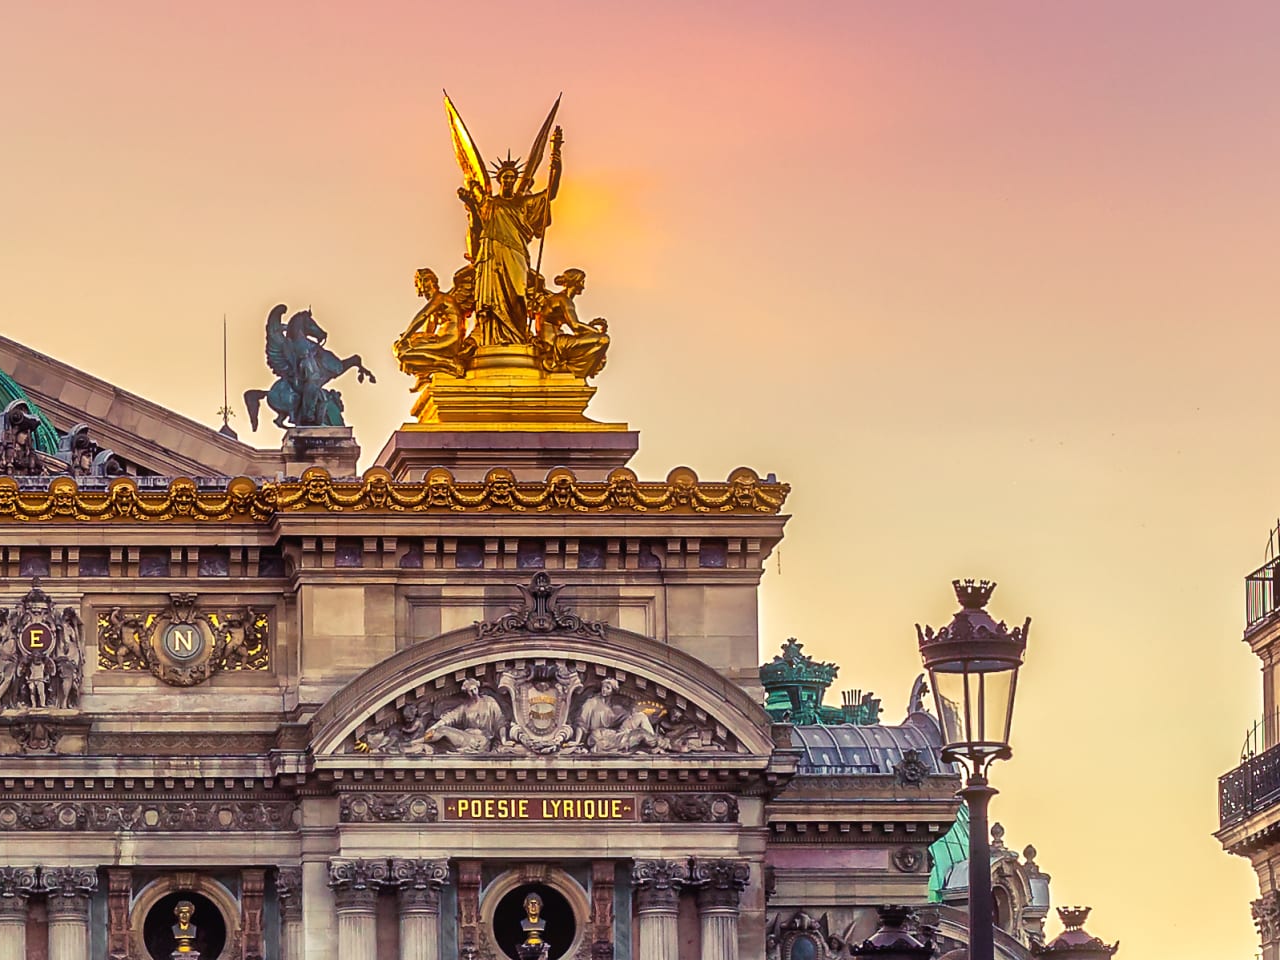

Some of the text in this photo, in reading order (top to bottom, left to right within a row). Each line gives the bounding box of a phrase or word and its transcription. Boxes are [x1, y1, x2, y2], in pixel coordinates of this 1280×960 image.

[29, 630, 44, 647] E
[174, 630, 193, 651] N
[458, 799, 623, 819] POESIE LYRIQUE
